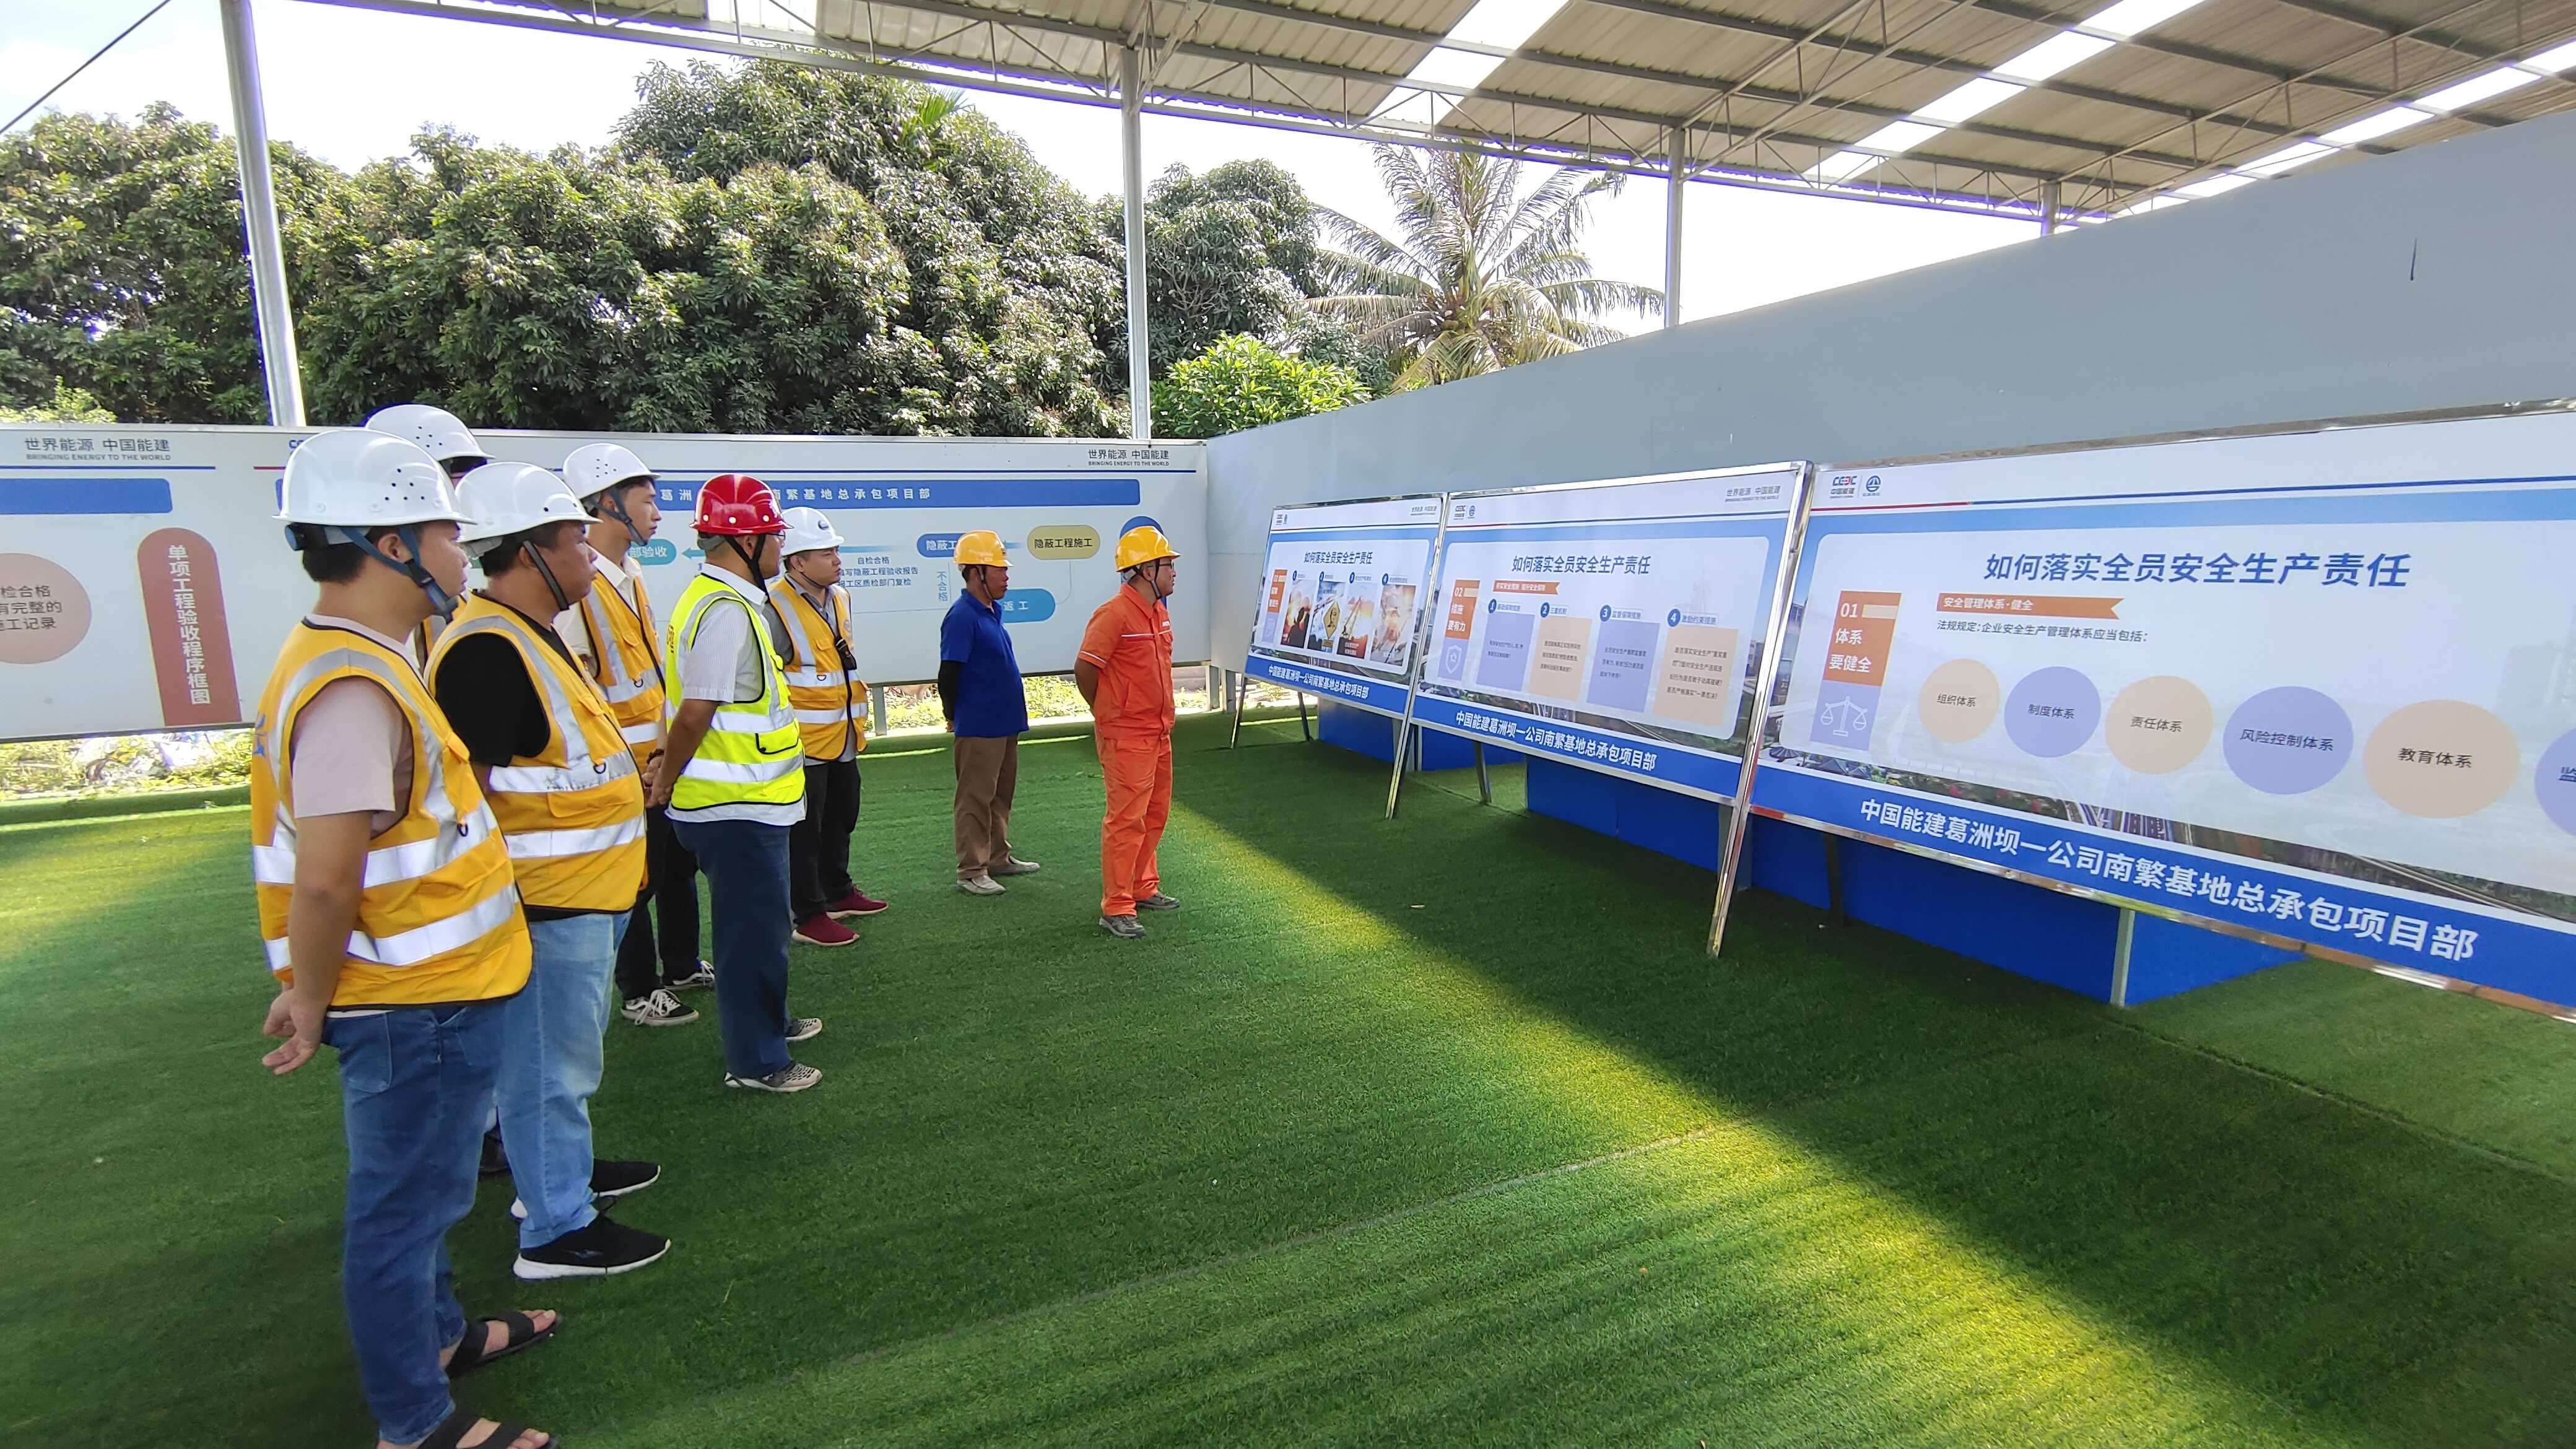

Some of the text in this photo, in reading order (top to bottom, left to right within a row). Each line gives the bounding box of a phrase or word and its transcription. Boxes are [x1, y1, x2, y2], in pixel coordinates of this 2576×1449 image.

[25, 438, 170, 452] 世界能源 中国能建
[1088, 449, 1169, 459] 世界能源 中国能建
[1832, 475, 1858, 486] CEEC
[1034, 537, 1094, 549] 隐蔽工程施工
[857, 557, 890, 565] 自检合格
[1511, 555, 1651, 575] 如何落实全员安全生产责任
[1983, 552, 2413, 588] 如何落实全员安全生产责任
[1, 585, 51, 599] 检合格
[1455, 587, 1463, 598] 02
[1003, 600, 1029, 611] 返工
[1840, 602, 1858, 619] 01
[1943, 598, 2034, 611] 安全管理体系·健全
[168, 544, 211, 705] 单项工程验收程序框图
[1447, 620, 1466, 632] 要有力
[1835, 627, 1863, 646] 体系
[1828, 654, 1873, 674] 要健全
[1936, 692, 1978, 708] 组织体系
[2027, 703, 2075, 721] 制度体系
[2129, 715, 2183, 733] 责任体系
[1455, 710, 1657, 772] 中国能建葛洲坝一公司南繁基地总承包项目部
[2239, 728, 2334, 751] 风险控制体系
[2398, 747, 2473, 769] 教育体系
[1860, 797, 2479, 963] 中国能建葛洲坝一公司南繁基地总承包项目部
